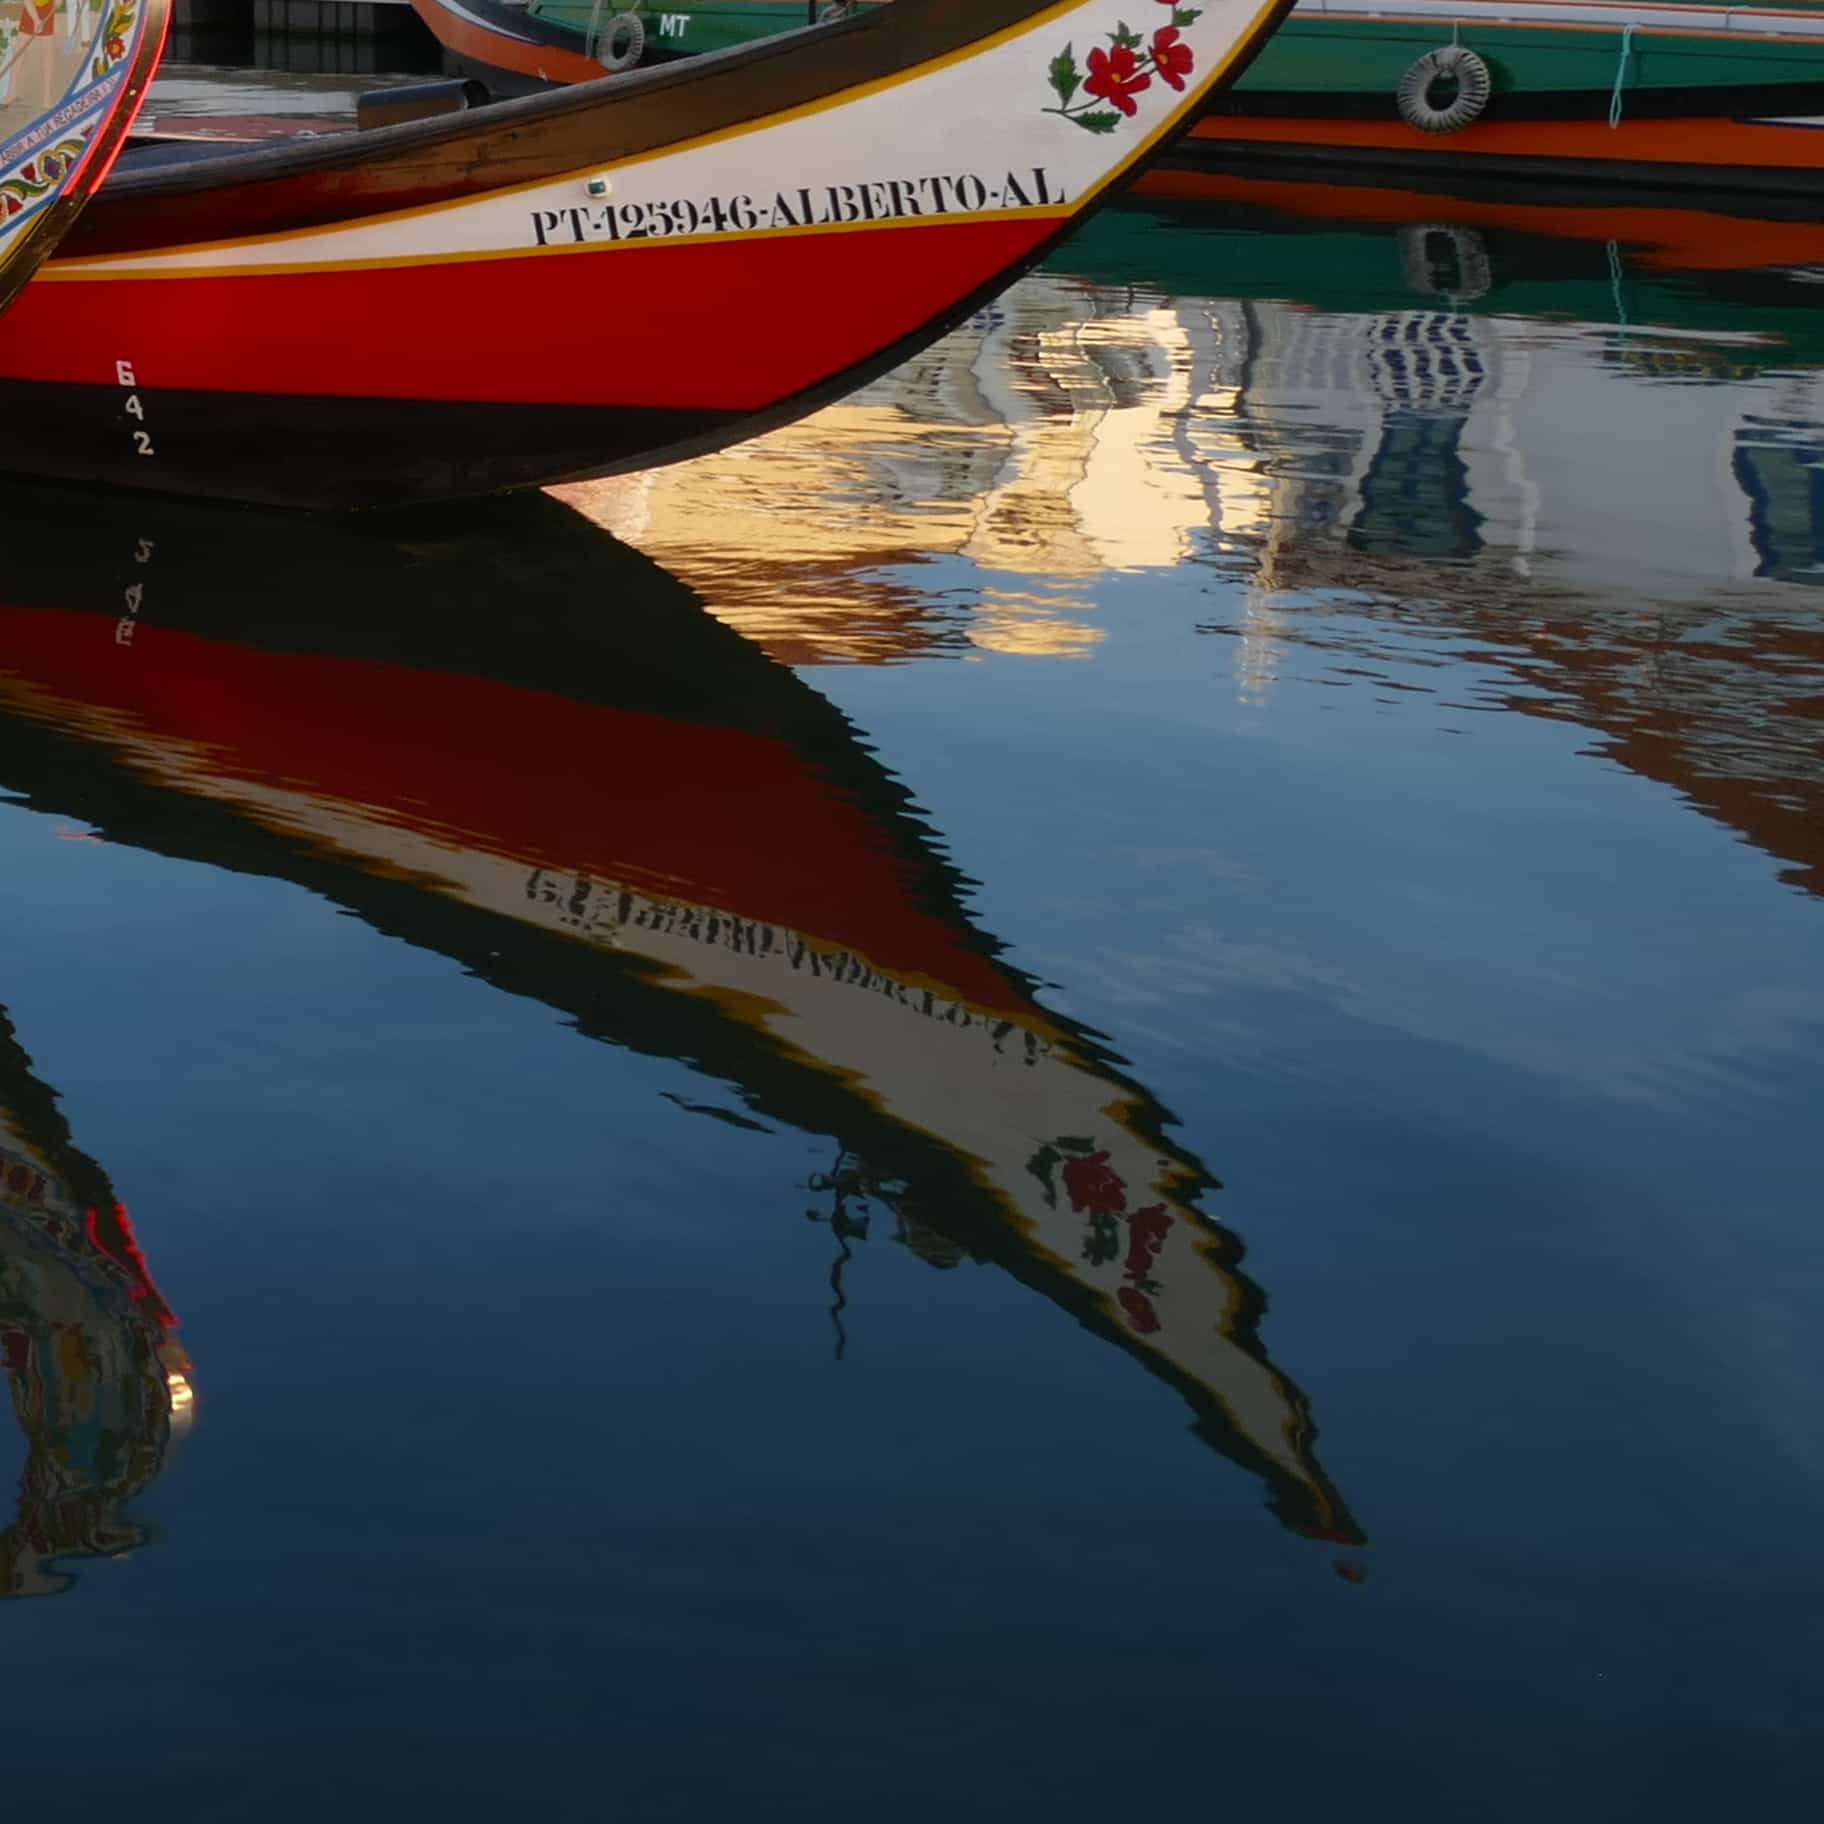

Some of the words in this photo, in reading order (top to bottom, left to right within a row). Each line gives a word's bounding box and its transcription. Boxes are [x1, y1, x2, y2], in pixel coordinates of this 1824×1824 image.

[659, 13, 690, 37] MT
[530, 167, 1065, 246] PT-125946-ALBERTO-AL
[115, 360, 136, 386] 6
[125, 395, 143, 421] 4
[133, 431, 154, 455] 2
